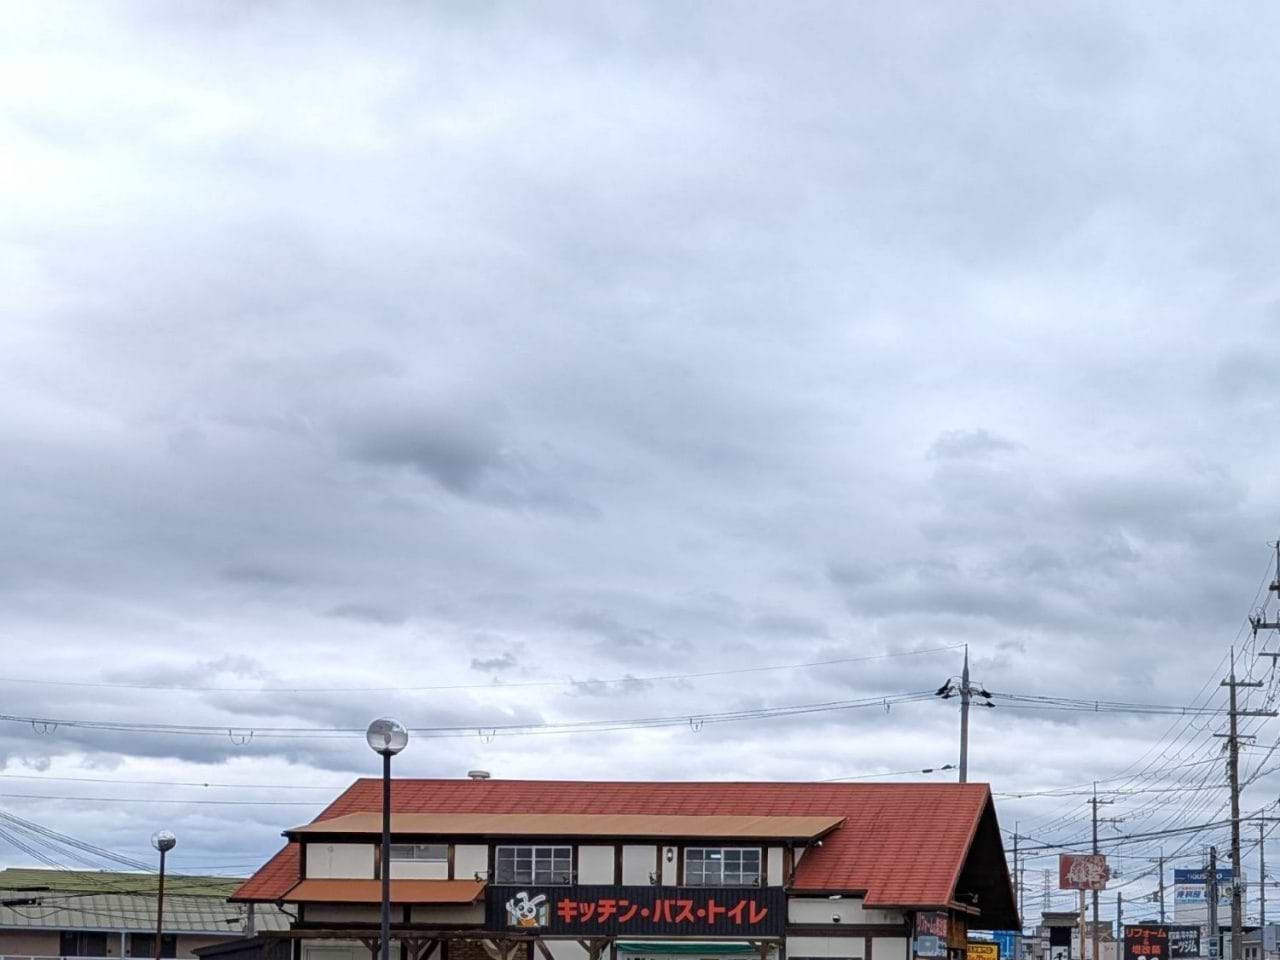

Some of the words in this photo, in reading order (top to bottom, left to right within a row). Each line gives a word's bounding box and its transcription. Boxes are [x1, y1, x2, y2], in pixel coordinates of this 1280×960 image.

[557, 898, 769, 925] キッチン・バス・トイレ
[1126, 928, 1167, 938] リフォーム
